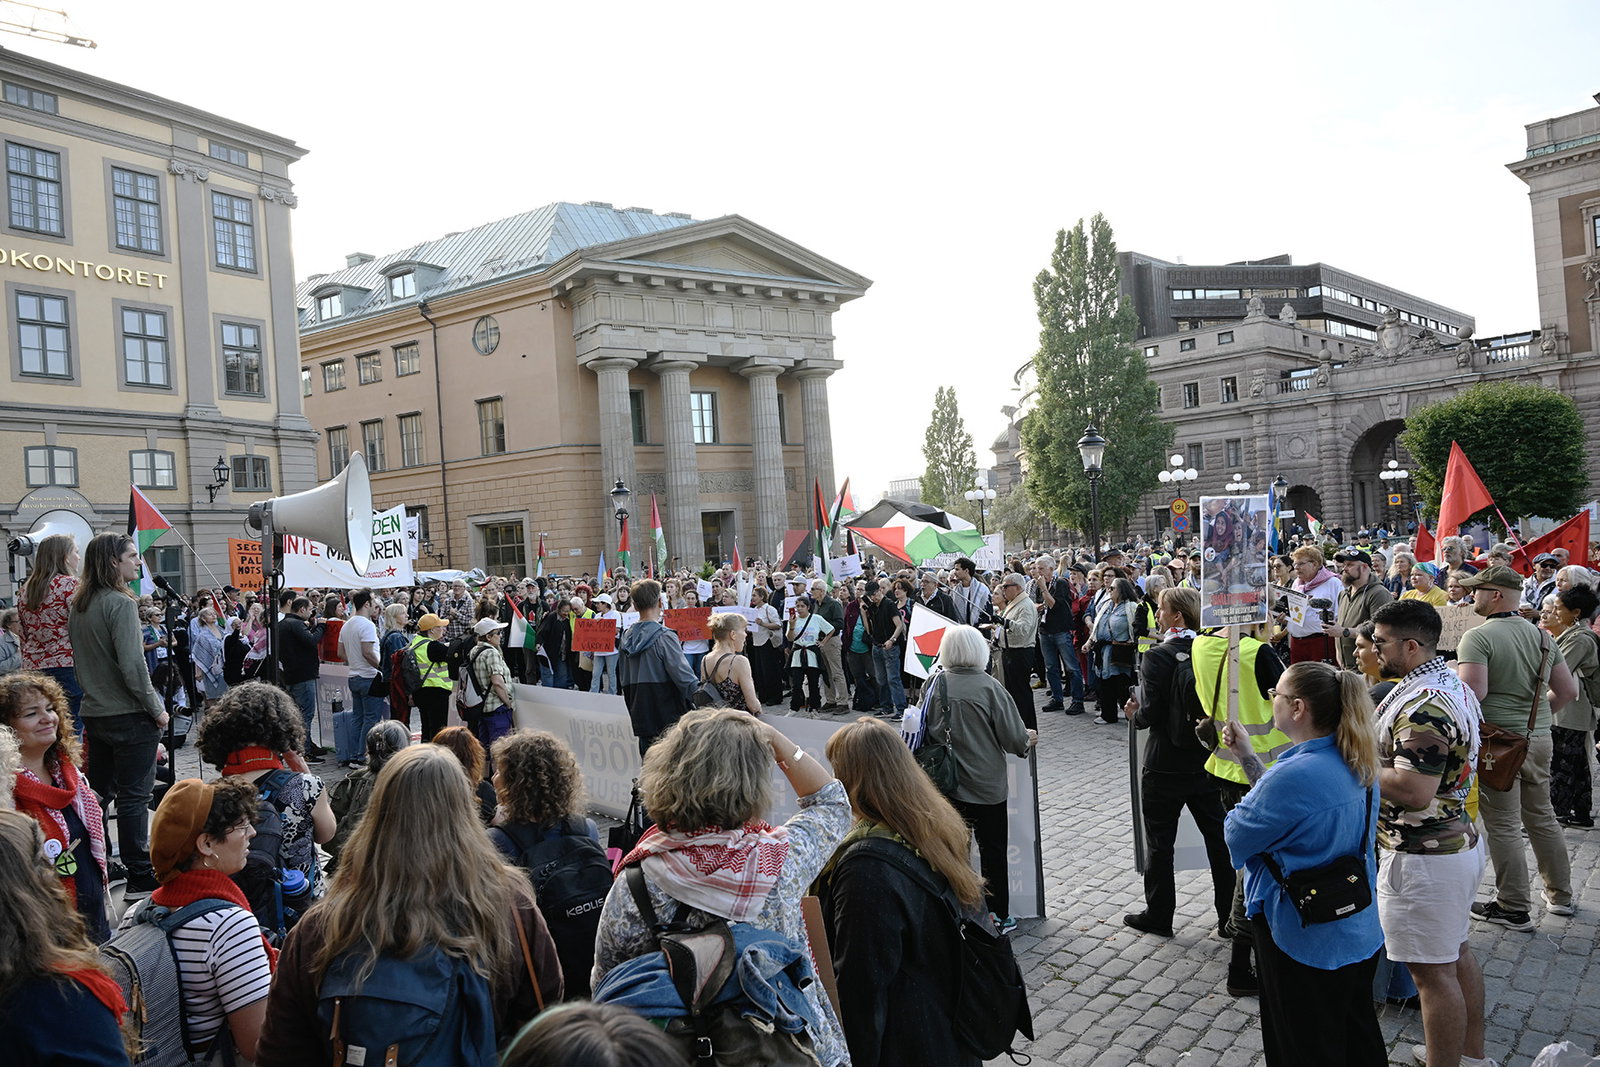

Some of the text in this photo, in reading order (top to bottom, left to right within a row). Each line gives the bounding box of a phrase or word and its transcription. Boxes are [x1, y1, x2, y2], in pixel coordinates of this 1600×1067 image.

[371, 514, 401, 537] DEN
[241, 556, 262, 565] PAL
[238, 566, 261, 575] MOTS
[1443, 619, 1469, 632] OLKET
